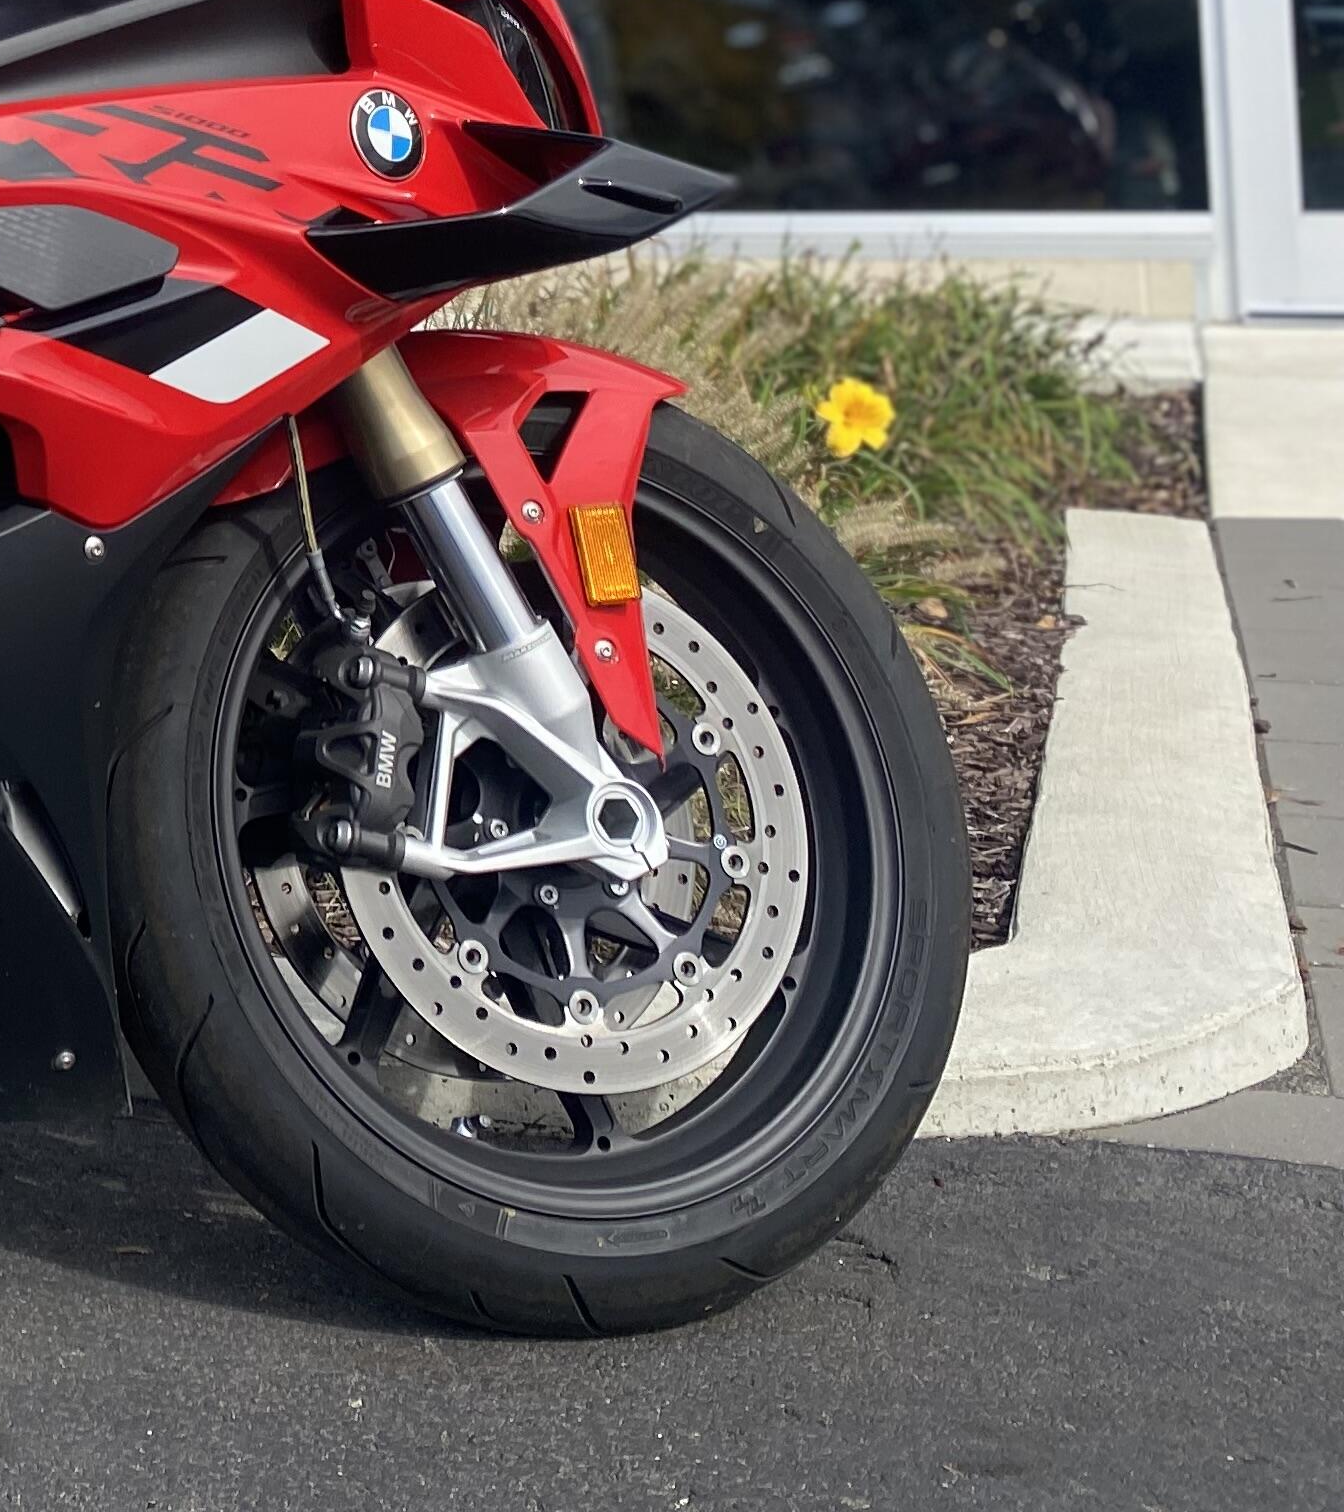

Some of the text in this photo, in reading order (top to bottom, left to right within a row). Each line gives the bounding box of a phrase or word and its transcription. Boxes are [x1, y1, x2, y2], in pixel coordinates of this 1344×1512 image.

[152, 105, 252, 138] S1000
[359, 91, 418, 126] BMW
[376, 730, 397, 788] BMW
